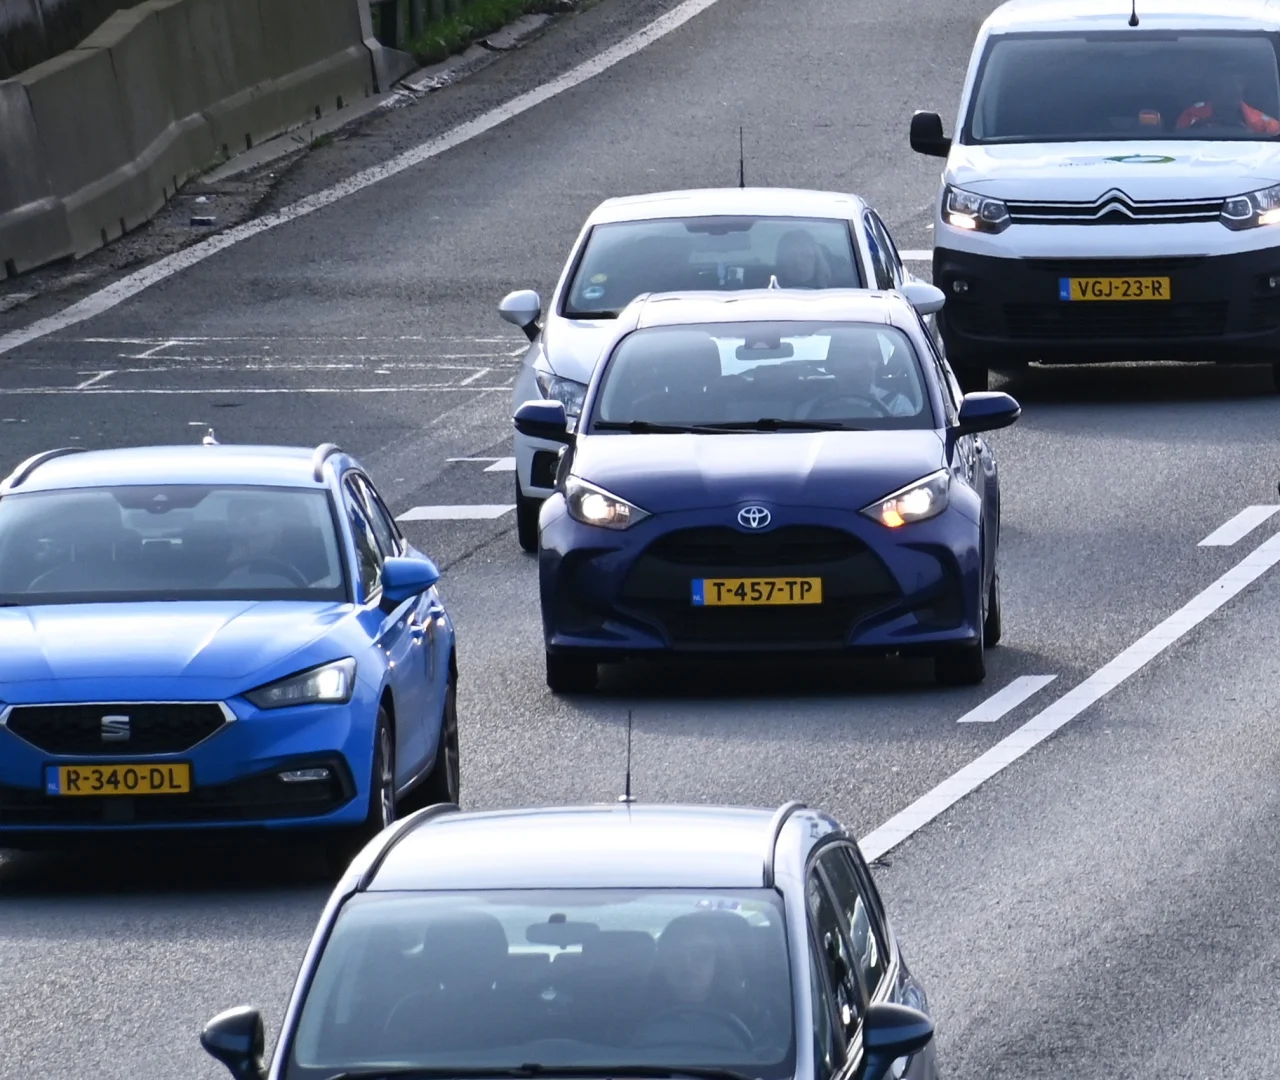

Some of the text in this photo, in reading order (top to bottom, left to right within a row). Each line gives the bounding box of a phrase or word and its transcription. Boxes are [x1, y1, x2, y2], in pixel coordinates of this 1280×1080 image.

[1078, 280, 1163, 298] VGJ-23-R
[713, 581, 813, 602] T-457-TP
[66, 768, 182, 791] R-340-DL
